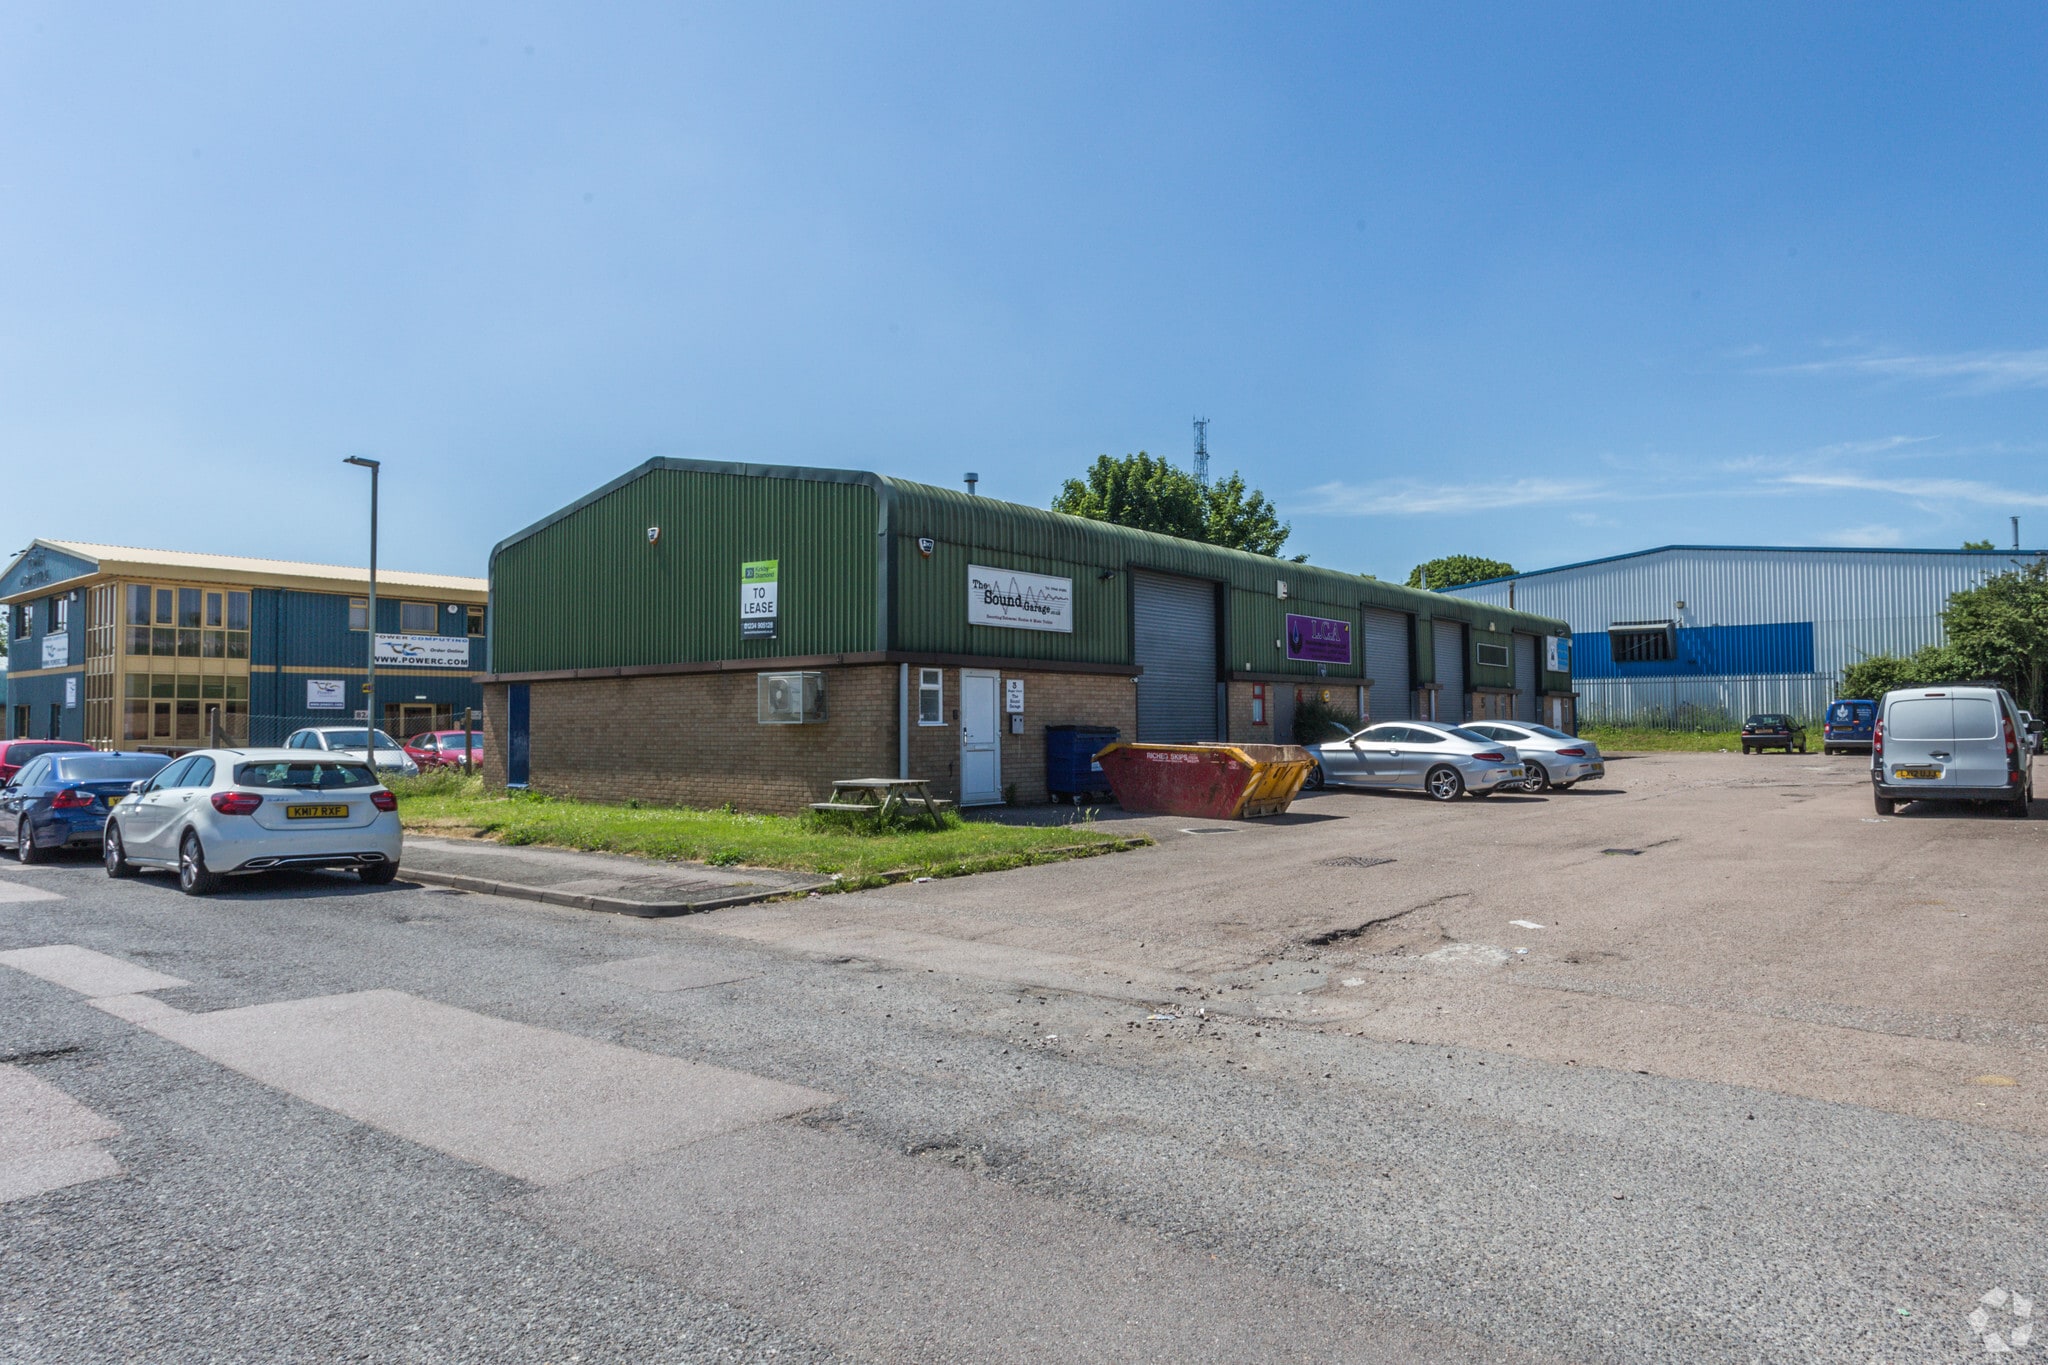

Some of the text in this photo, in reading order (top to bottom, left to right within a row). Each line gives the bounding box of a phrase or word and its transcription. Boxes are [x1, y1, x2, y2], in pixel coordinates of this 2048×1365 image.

[973, 579, 988, 590] The
[753, 587, 766, 599] TO
[744, 602, 774, 614] LEASE
[984, 589, 1023, 608] Sound
[1023, 601, 1051, 616] Garage
[321, 806, 341, 816] RXF
